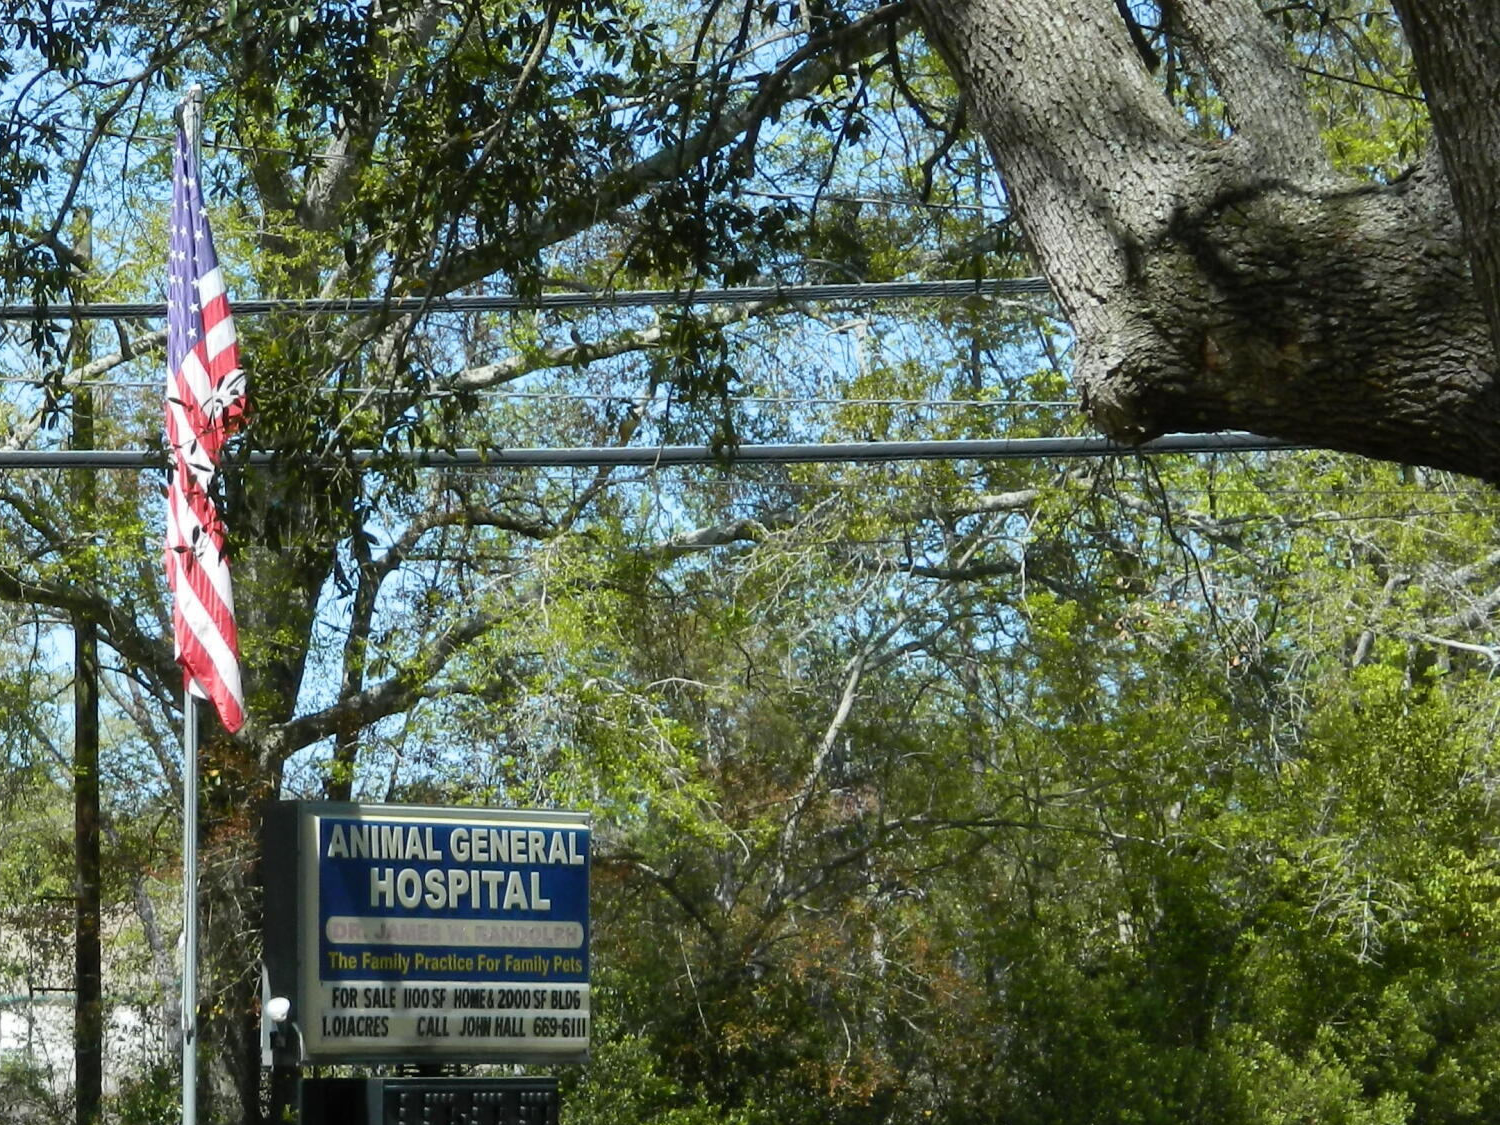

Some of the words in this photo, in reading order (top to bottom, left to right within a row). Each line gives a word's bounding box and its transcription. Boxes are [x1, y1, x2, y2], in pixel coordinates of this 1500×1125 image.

[327, 823, 442, 861] ANIMAL
[449, 827, 585, 865] GENERAL
[370, 867, 551, 911] HOSPITAL
[328, 951, 357, 970] The
[362, 951, 410, 975] Family
[415, 953, 473, 972] Practice
[477, 954, 501, 972] For
[505, 954, 549, 977] Family
[553, 955, 583, 973] Pets
[332, 987, 358, 1008] FOR
[363, 987, 396, 1009] SALE
[432, 988, 446, 1009] SF
[497, 989, 531, 1009] 2000
[533, 989, 547, 1009] SF
[550, 990, 581, 1009] BLDG
[416, 1016, 450, 1037] CALL
[459, 1016, 492, 1037] JOHN
[494, 1016, 526, 1038] HALL
